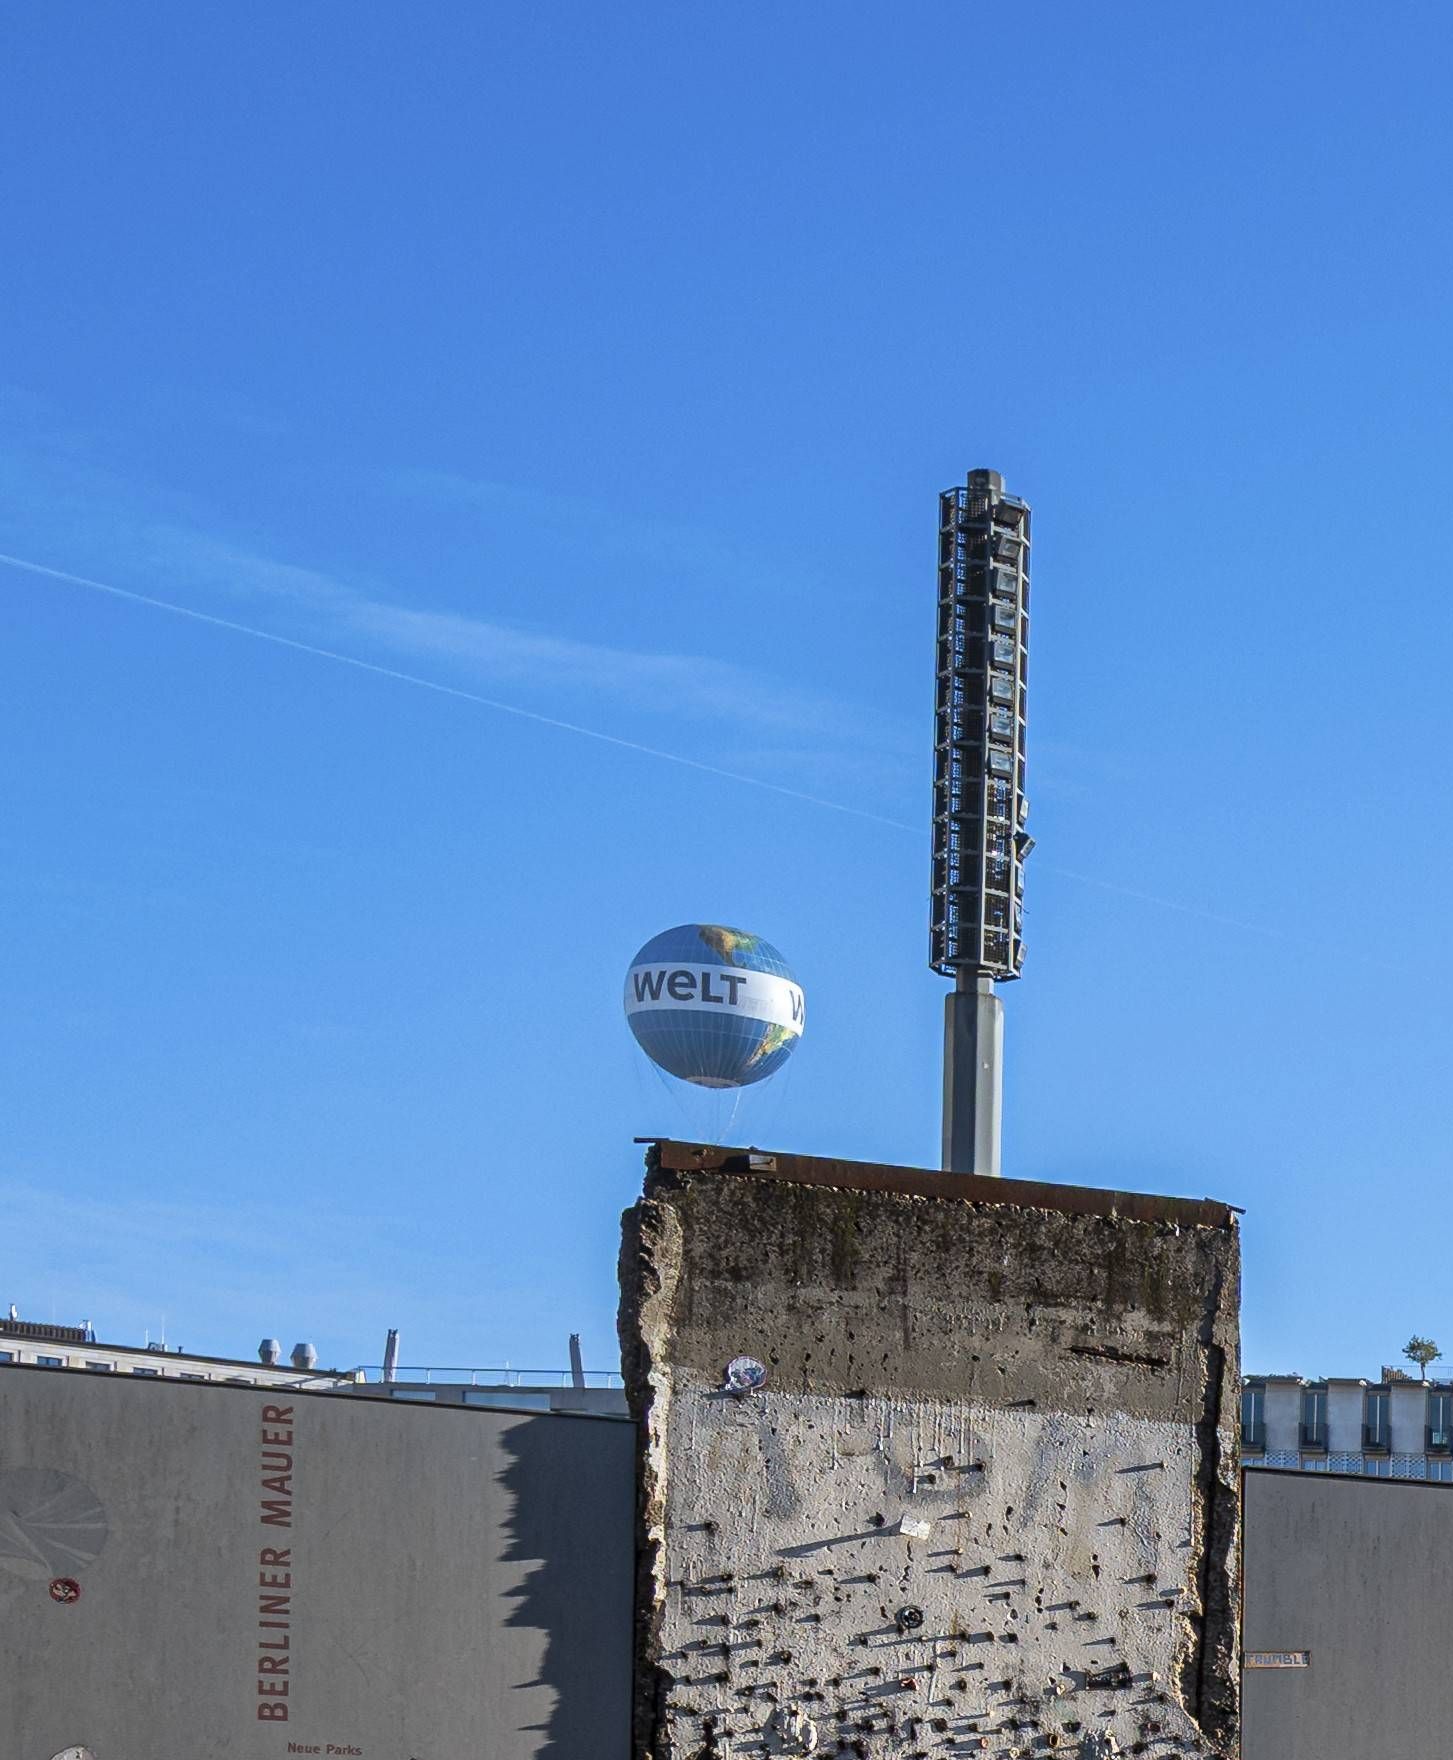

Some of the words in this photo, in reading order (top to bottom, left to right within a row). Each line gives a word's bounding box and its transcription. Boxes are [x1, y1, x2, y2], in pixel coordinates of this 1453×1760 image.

[260, 1404, 294, 1527] MAUER
[258, 1547, 291, 1722] BERLINER
[287, 1741, 321, 1755] Neue
[326, 1742, 362, 1756] Parks
